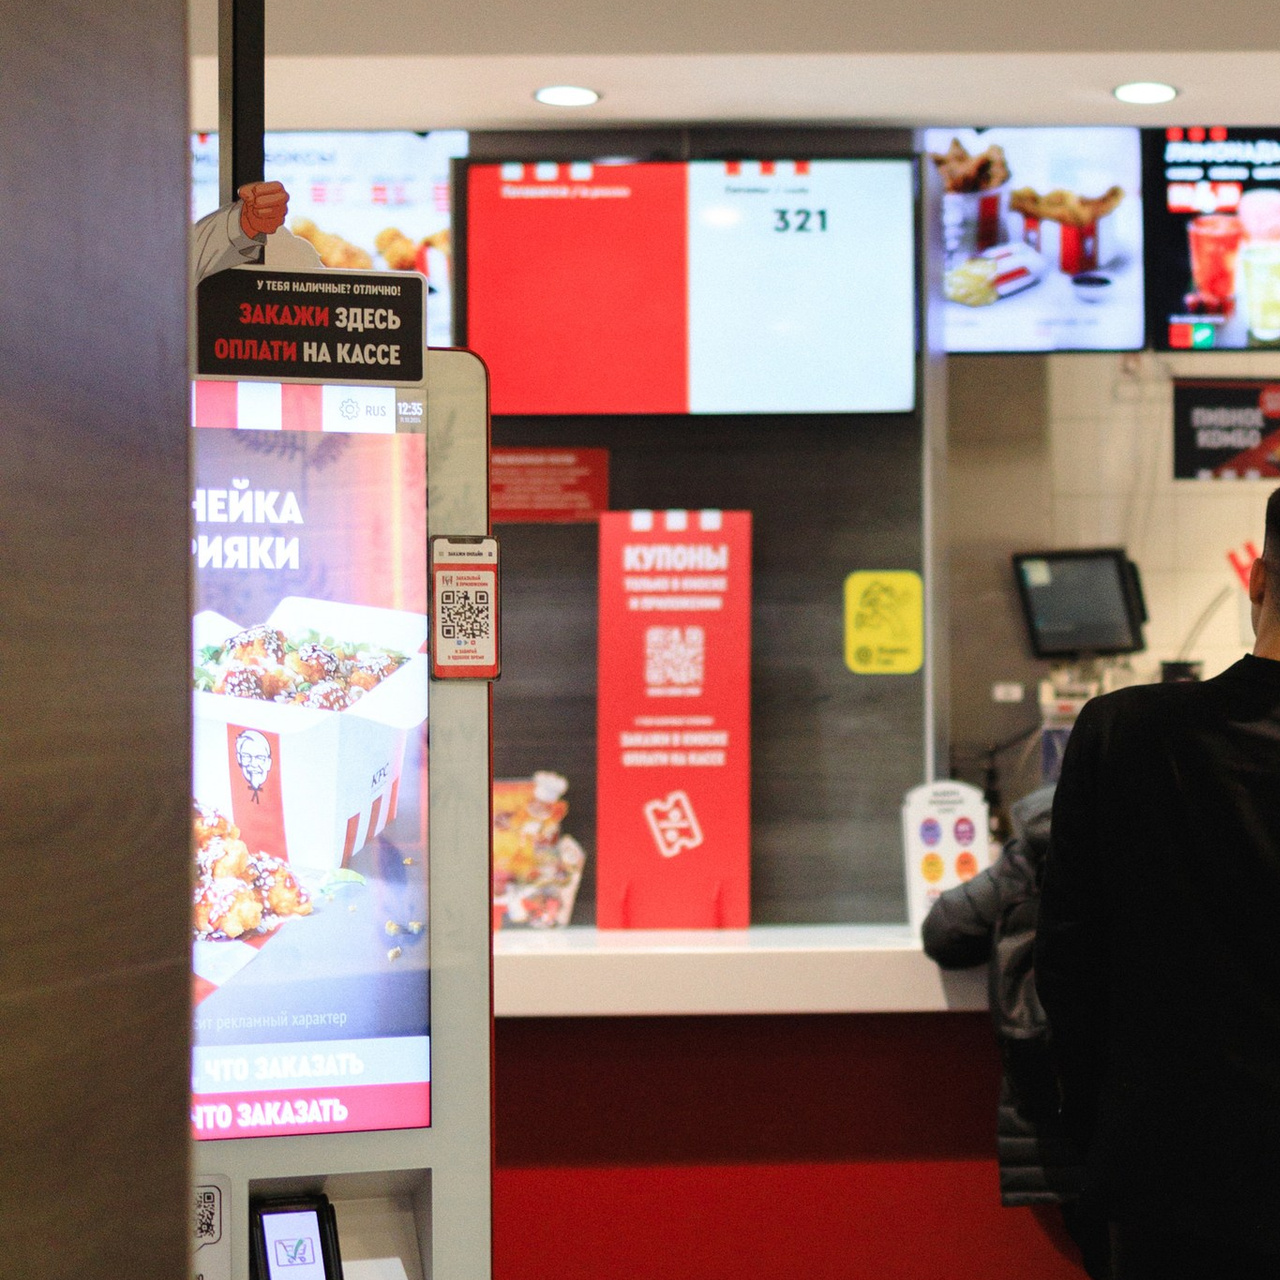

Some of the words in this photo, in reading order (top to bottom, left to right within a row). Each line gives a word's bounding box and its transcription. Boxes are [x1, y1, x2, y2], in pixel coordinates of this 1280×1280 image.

[774, 208, 828, 233] 321
[256, 279, 266, 291] У
[266, 280, 290, 292] ТЕБЯ
[292, 281, 351, 295] НАЛИЧНЫЕ?
[353, 285, 401, 296] ОТЛИЧНО!
[239, 303, 329, 327] ЗАКАЖИ
[335, 307, 401, 332] ЗДЕСЬ
[214, 338, 297, 362] ОПЛАТИ
[303, 342, 331, 363] НА
[337, 343, 401, 365] КАССЕ
[365, 405, 387, 417] RUS
[397, 402, 423, 416] 12:35
[192, 535, 300, 570] ИЯКИ
[622, 543, 730, 572] КУПОНЫ
[371, 762, 389, 788] KFC
[216, 1011, 288, 1032] рекламный
[292, 1012, 347, 1029] характер
[204, 1057, 249, 1082] ЧТО
[254, 1052, 365, 1081] ЗАКАЗАТЬ
[237, 1098, 349, 1129] ЗАКАЗАТЬ
